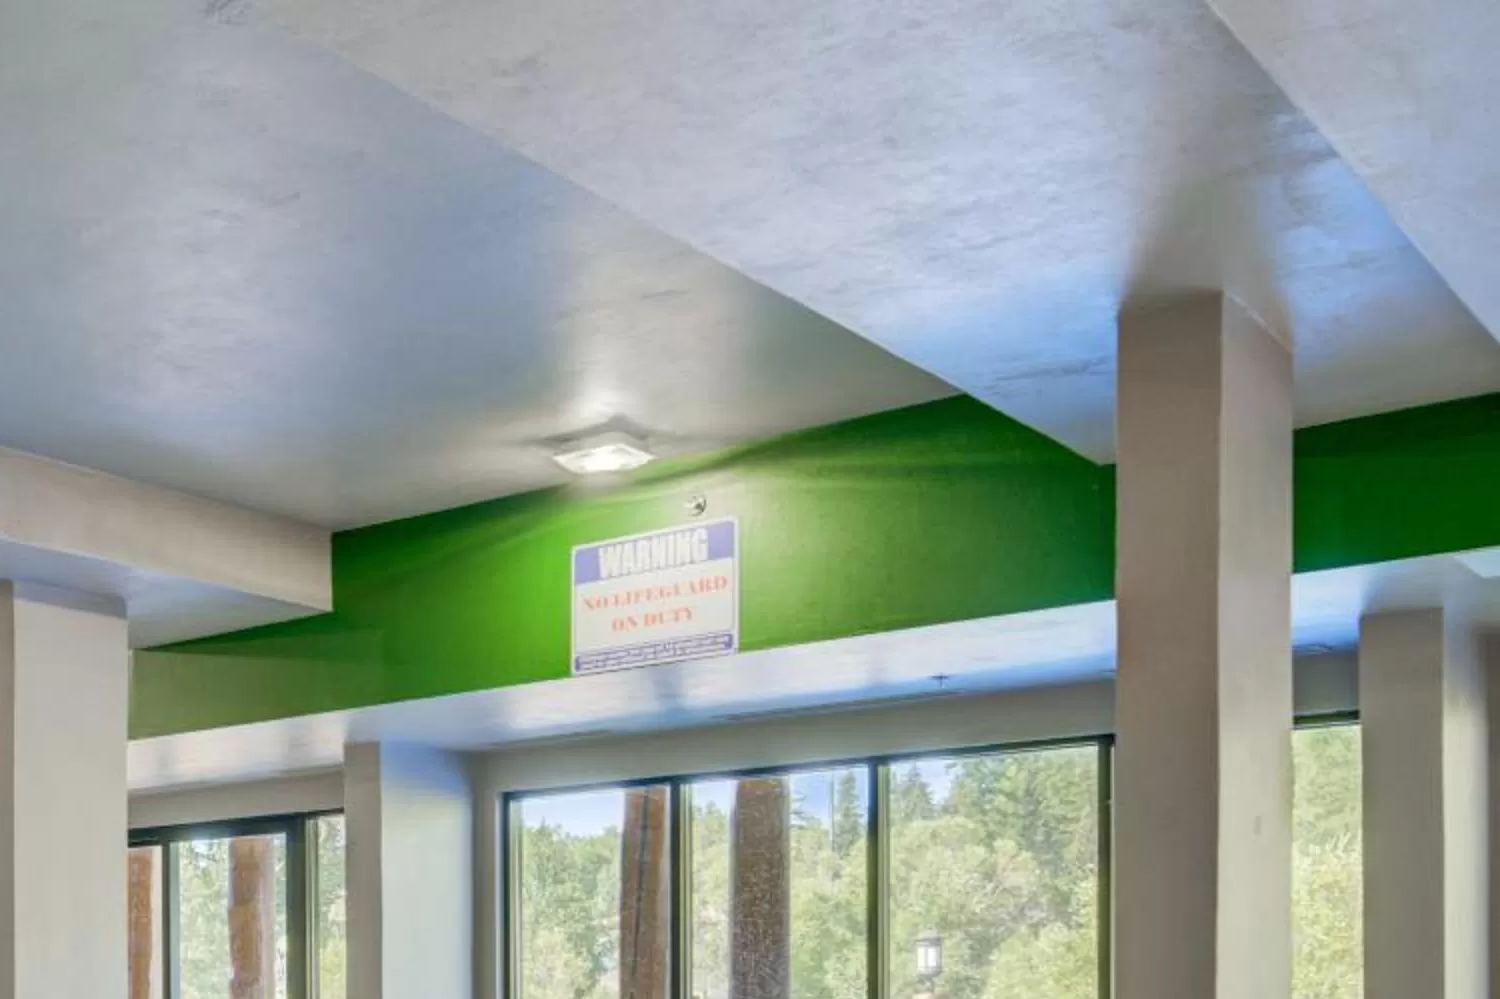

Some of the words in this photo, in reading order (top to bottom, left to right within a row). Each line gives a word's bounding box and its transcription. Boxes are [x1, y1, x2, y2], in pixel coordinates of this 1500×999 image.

[599, 527, 708, 580] WARNING
[582, 592, 607, 611] NO
[611, 575, 728, 607] LIFEGUARD
[611, 614, 637, 633] ON
[643, 606, 694, 627] DUTY
